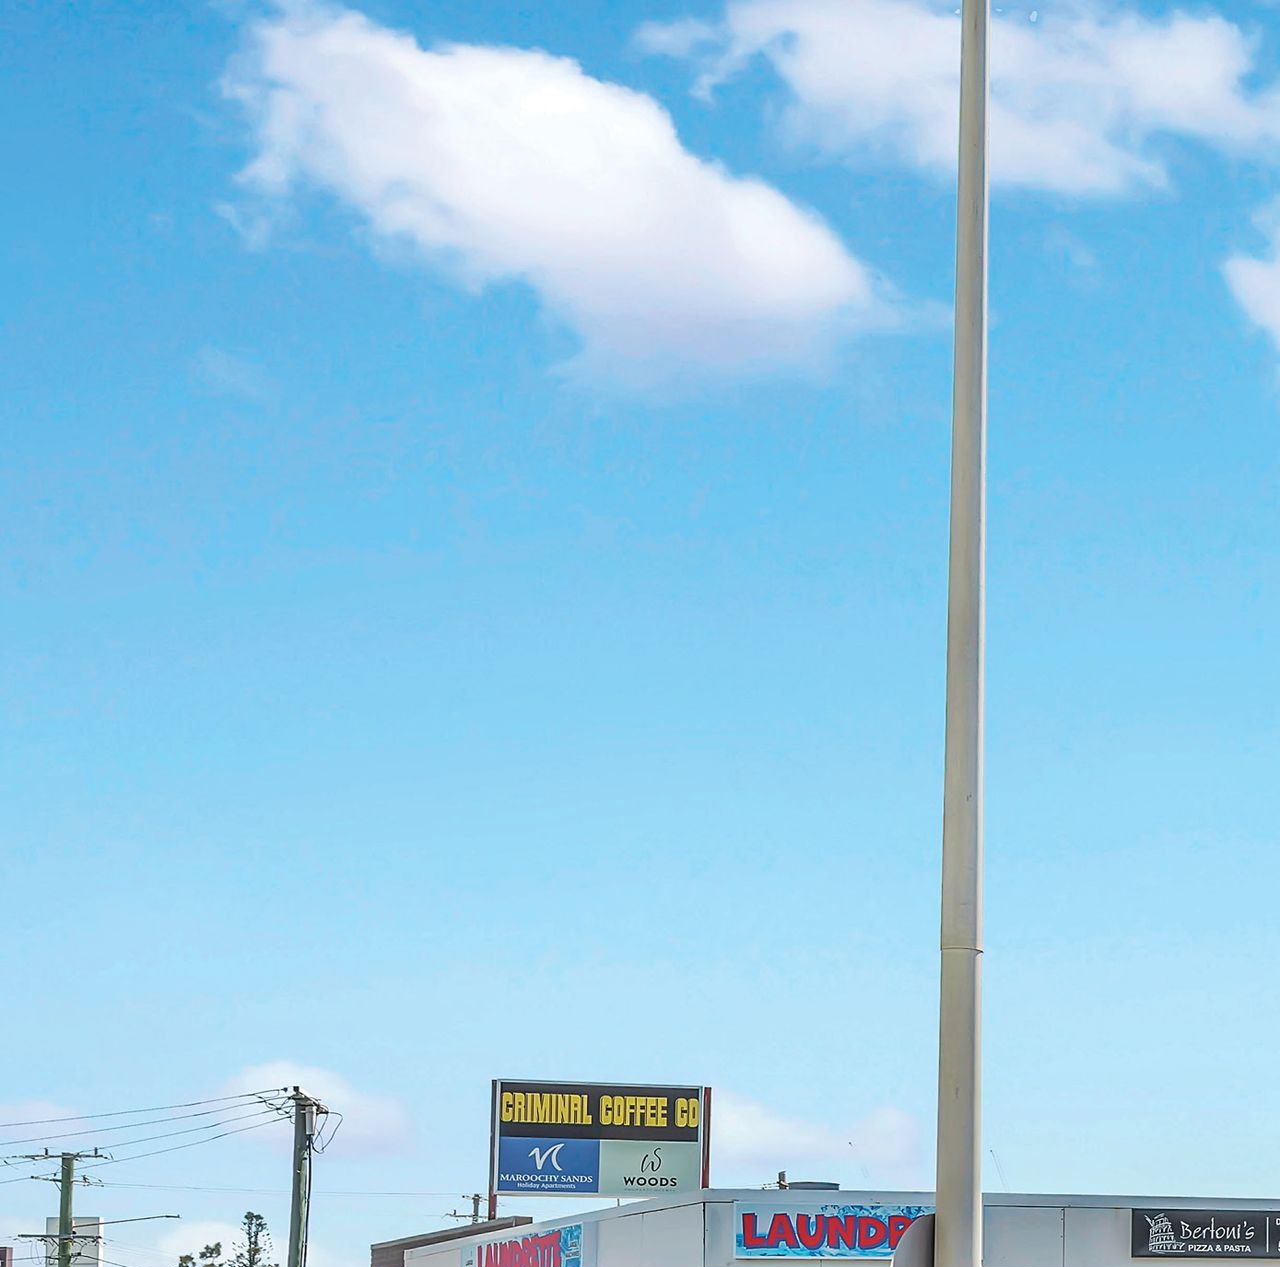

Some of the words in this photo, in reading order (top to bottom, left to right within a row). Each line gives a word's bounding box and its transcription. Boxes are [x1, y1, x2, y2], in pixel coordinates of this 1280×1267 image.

[500, 1091, 593, 1125] CRIMINAL
[600, 1095, 668, 1127] COFFEE
[674, 1097, 699, 1128] CO
[500, 1173, 560, 1183] MAROOCHY
[561, 1175, 593, 1183] SANDS
[623, 1176, 677, 1187] WOODS
[541, 1182, 576, 1190] Apartments
[742, 1212, 924, 1251] LAUNDR
[1179, 1217, 1255, 1240] Bertoni's
[1188, 1244, 1215, 1252] PIZZA
[1216, 1244, 1222, 1252] &
[1224, 1244, 1251, 1252] PASTA
